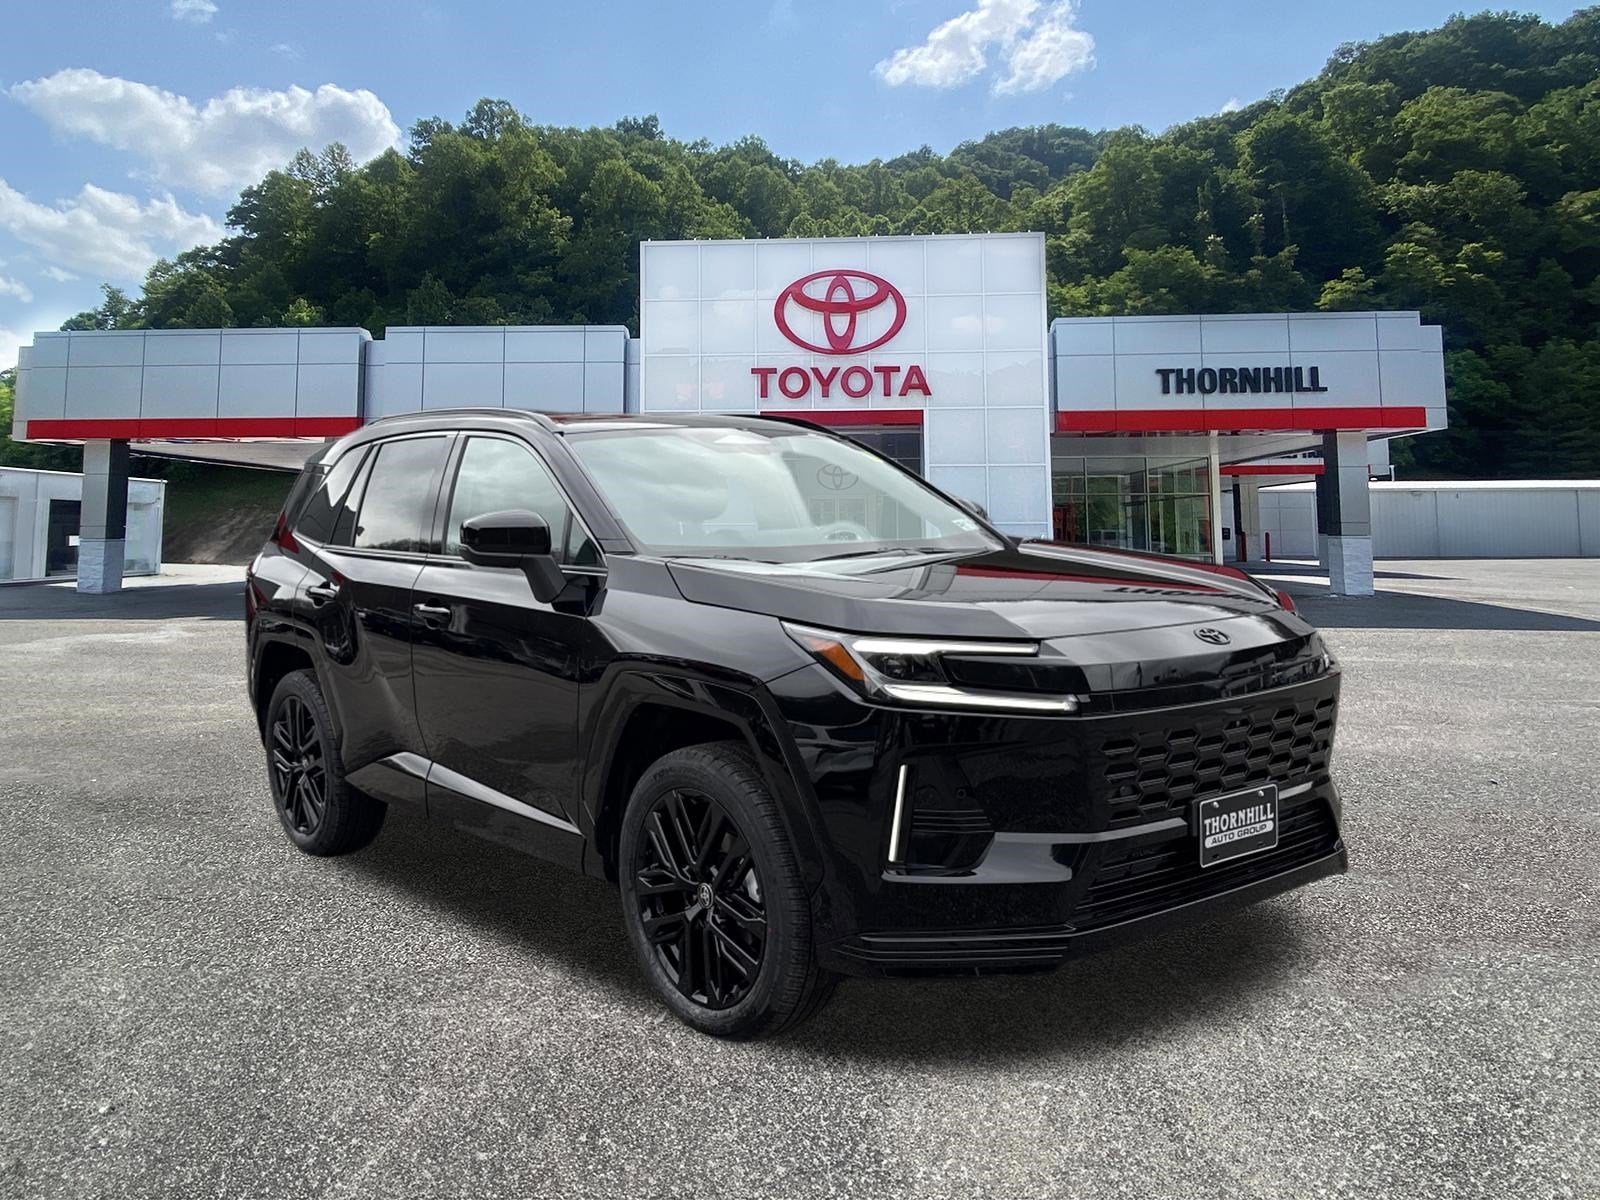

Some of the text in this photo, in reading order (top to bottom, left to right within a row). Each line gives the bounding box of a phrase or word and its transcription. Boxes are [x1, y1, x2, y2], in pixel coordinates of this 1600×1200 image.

[750, 365, 933, 399] TOYOTA
[1155, 366, 1328, 395] THORNHILL
[1203, 802, 1275, 836] THORNHILL
[1210, 823, 1268, 845] AUTO GROUP
